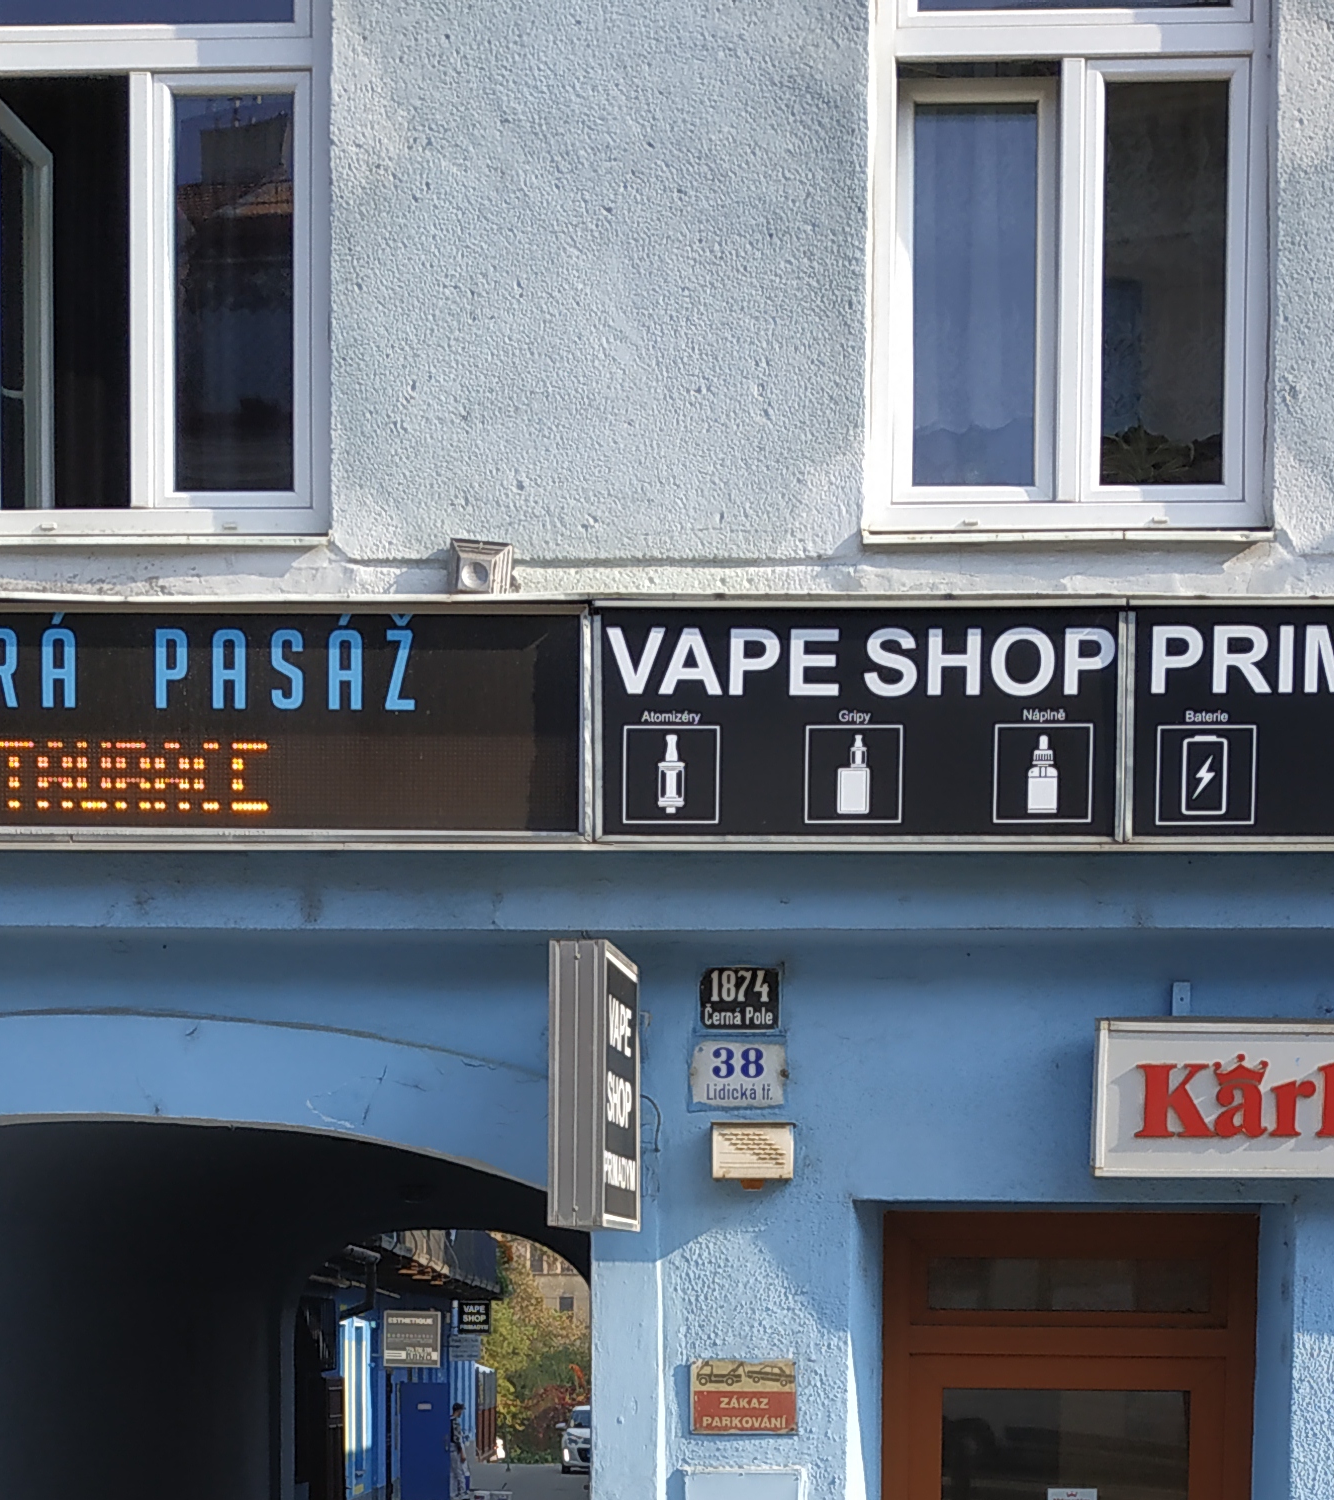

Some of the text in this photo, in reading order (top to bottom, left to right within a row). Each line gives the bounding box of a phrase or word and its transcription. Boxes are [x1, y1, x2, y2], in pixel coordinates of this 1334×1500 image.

[154, 613, 416, 711] PASÁŽ
[606, 627, 1117, 697] VAPE SHOP
[641, 710, 701, 725] Atomizéry
[838, 710, 871, 725] Gripy
[1023, 708, 1066, 722] Náplně
[1185, 710, 1229, 723] Baterie
[710, 969, 770, 1002] 1874
[704, 1003, 773, 1025] Černá Pole
[608, 994, 632, 1057] VAPE
[711, 1046, 765, 1079] 38
[607, 1071, 632, 1129] SHOP
[706, 1083, 757, 1101] Lidická
[463, 1305, 486, 1313] VAPE
[463, 1315, 487, 1323] SHOP
[720, 1396, 769, 1409] ZÁKAZ
[702, 1414, 786, 1428] PARKOVÁNÍ
